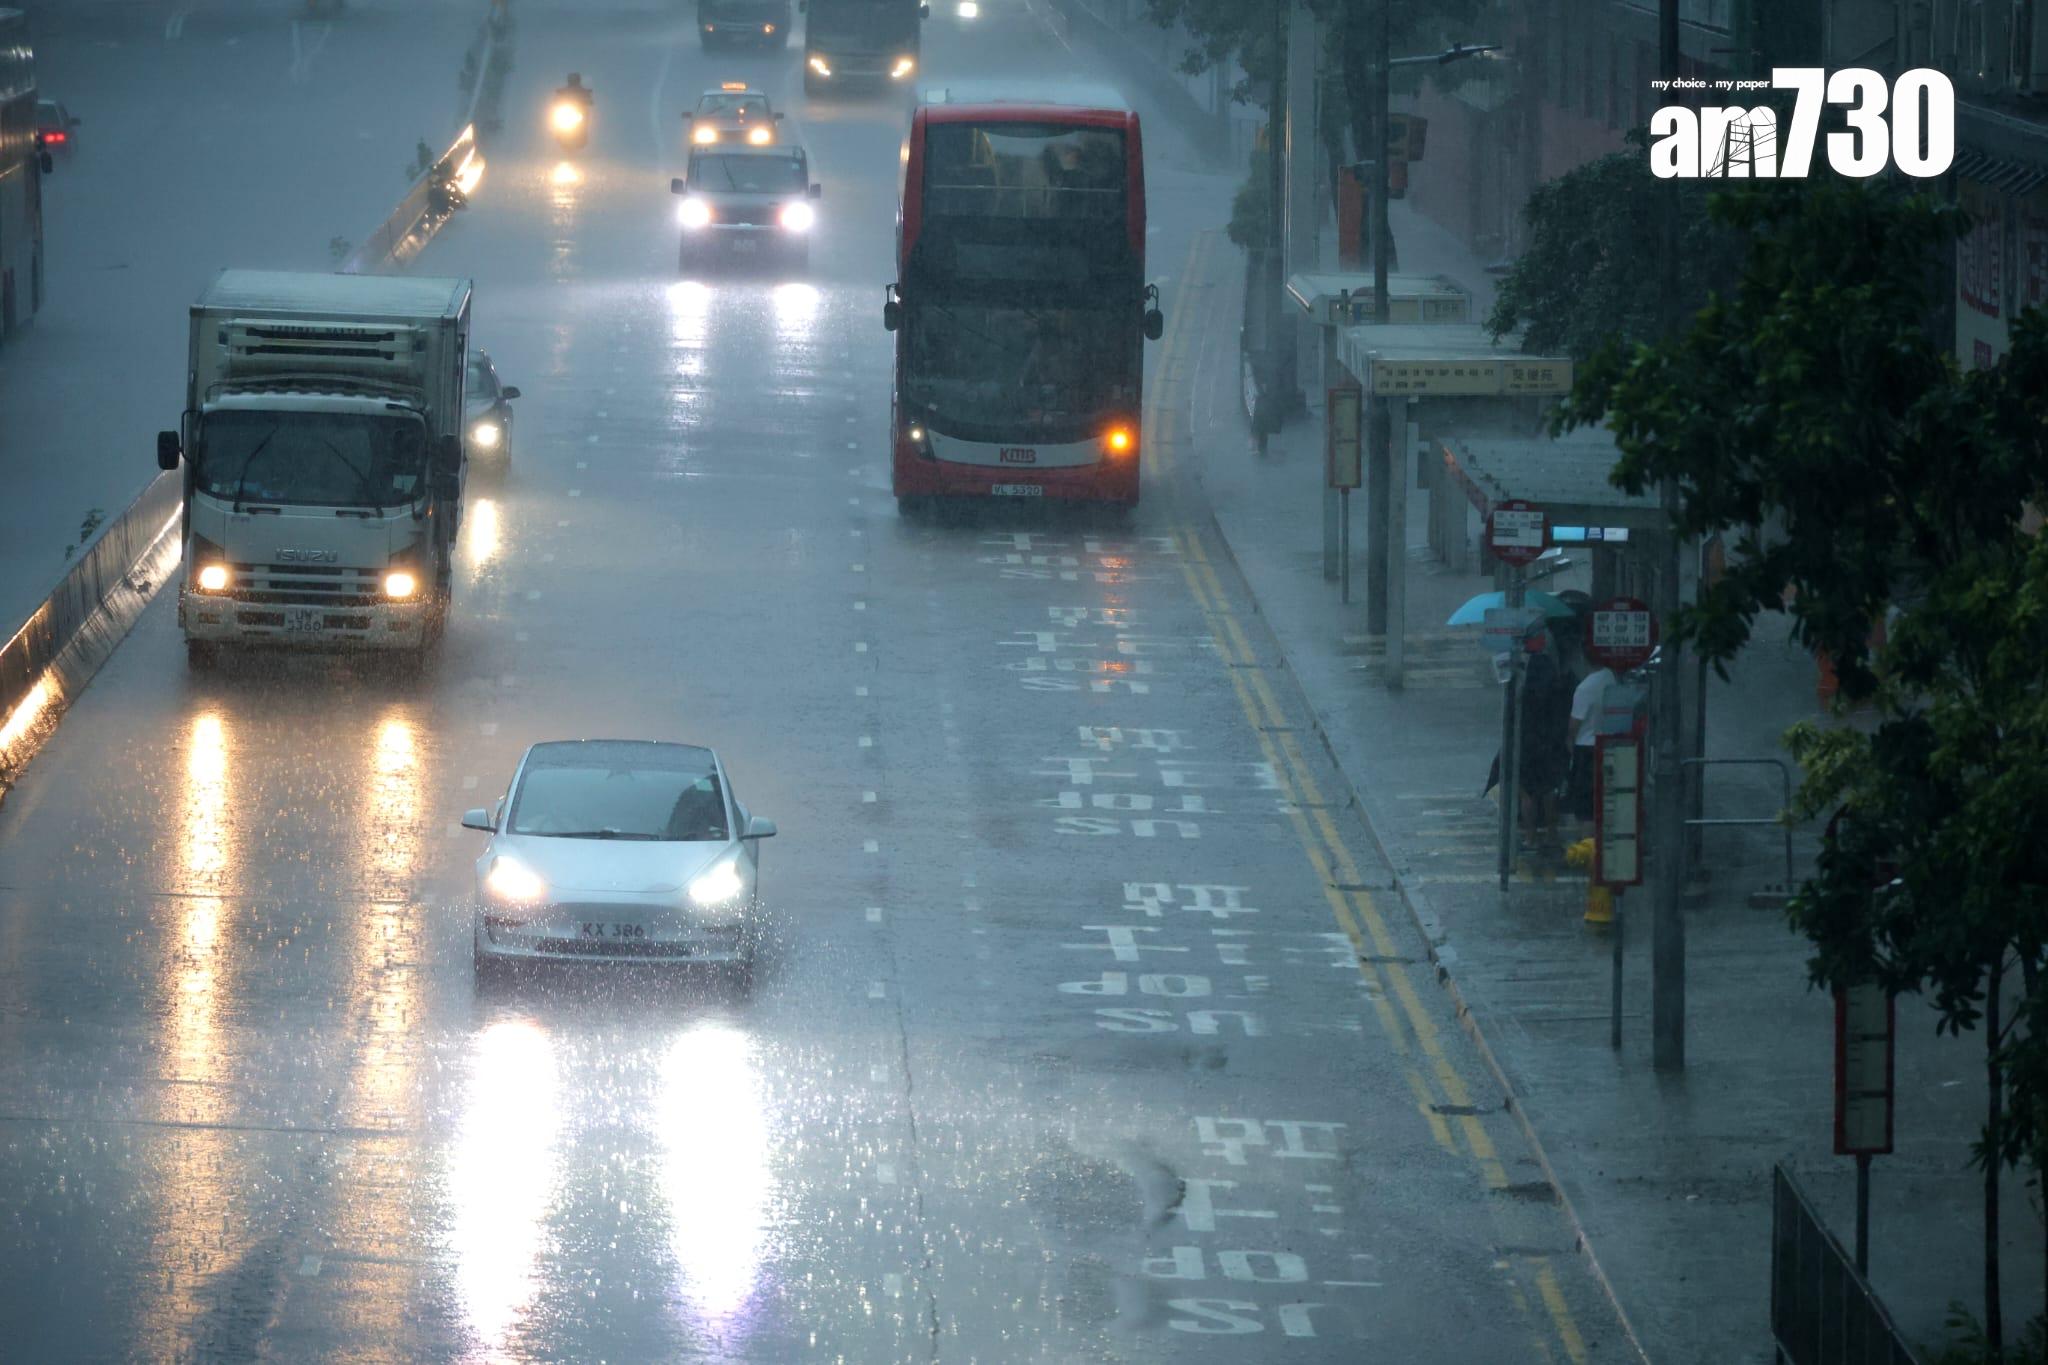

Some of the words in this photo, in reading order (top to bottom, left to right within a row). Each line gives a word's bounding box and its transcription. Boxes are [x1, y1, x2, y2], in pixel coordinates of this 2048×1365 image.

[999, 446, 1037, 464] KMB
[276, 548, 338, 563] ISUZU
[582, 922, 605, 937] KX
[612, 923, 644, 938] 386
